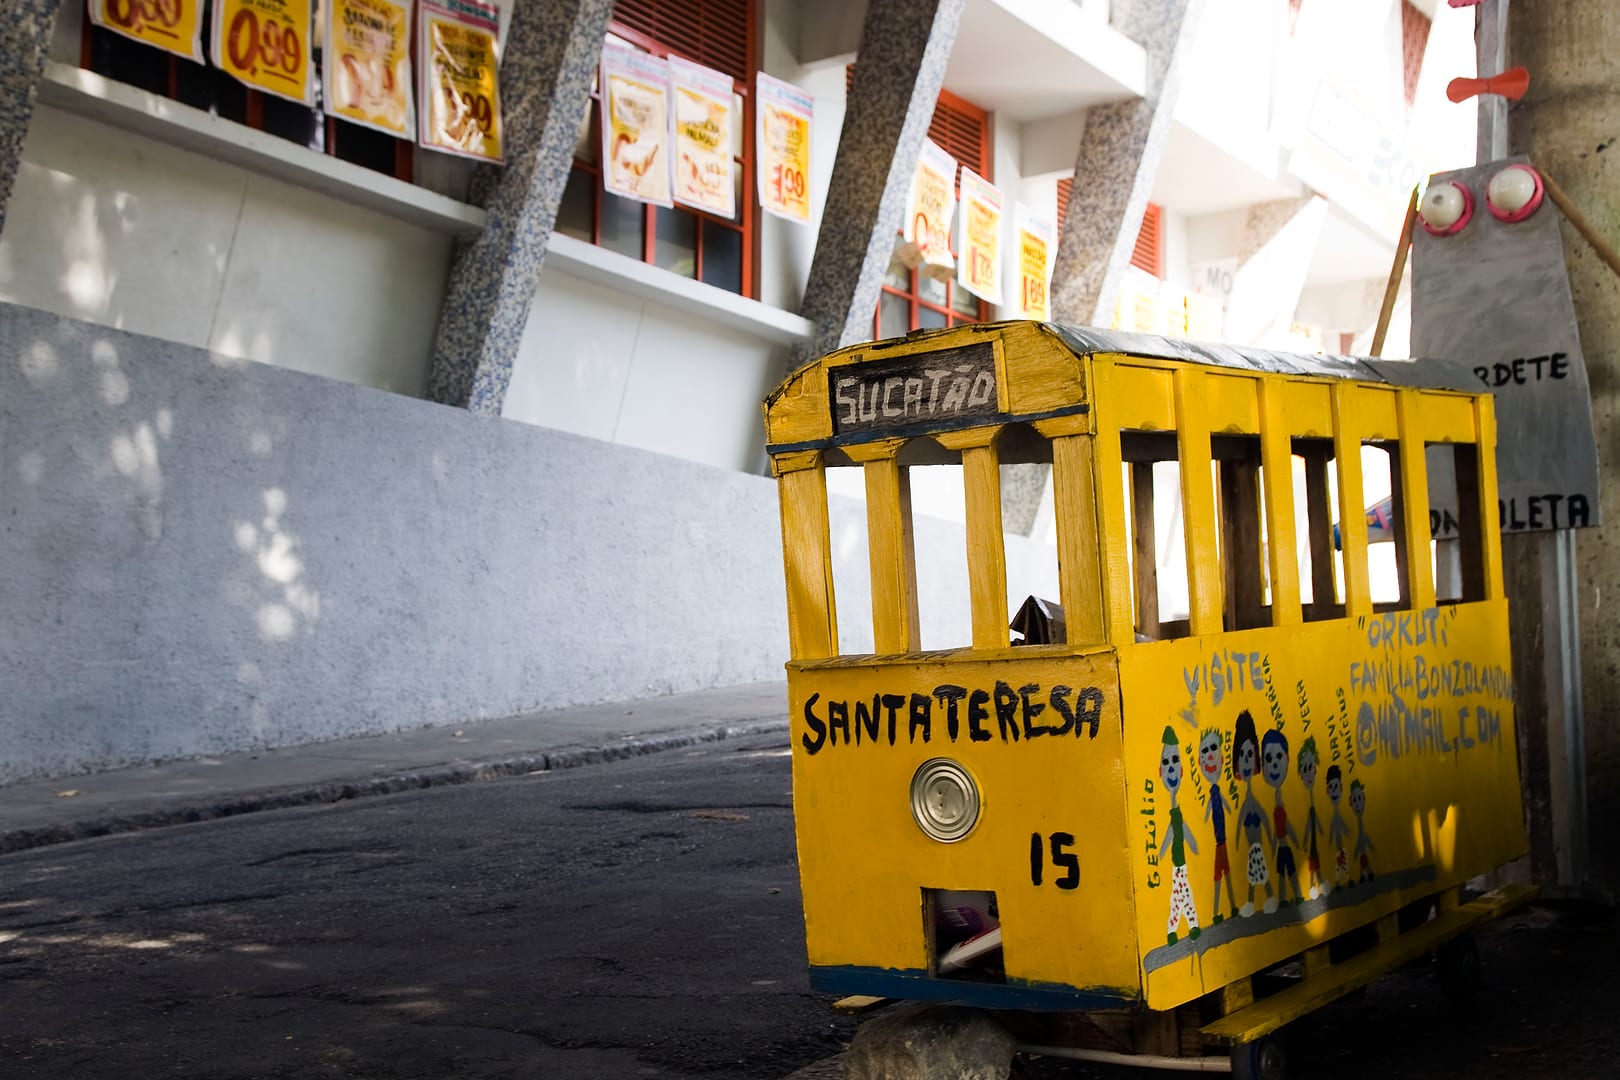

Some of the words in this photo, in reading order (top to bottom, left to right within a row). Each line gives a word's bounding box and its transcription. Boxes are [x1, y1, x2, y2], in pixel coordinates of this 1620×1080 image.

[802, 691, 932, 755] SANTA
[932, 680, 1105, 744] TERESA
[1296, 680, 1311, 733] VERA
[1030, 832, 1080, 890] 15
